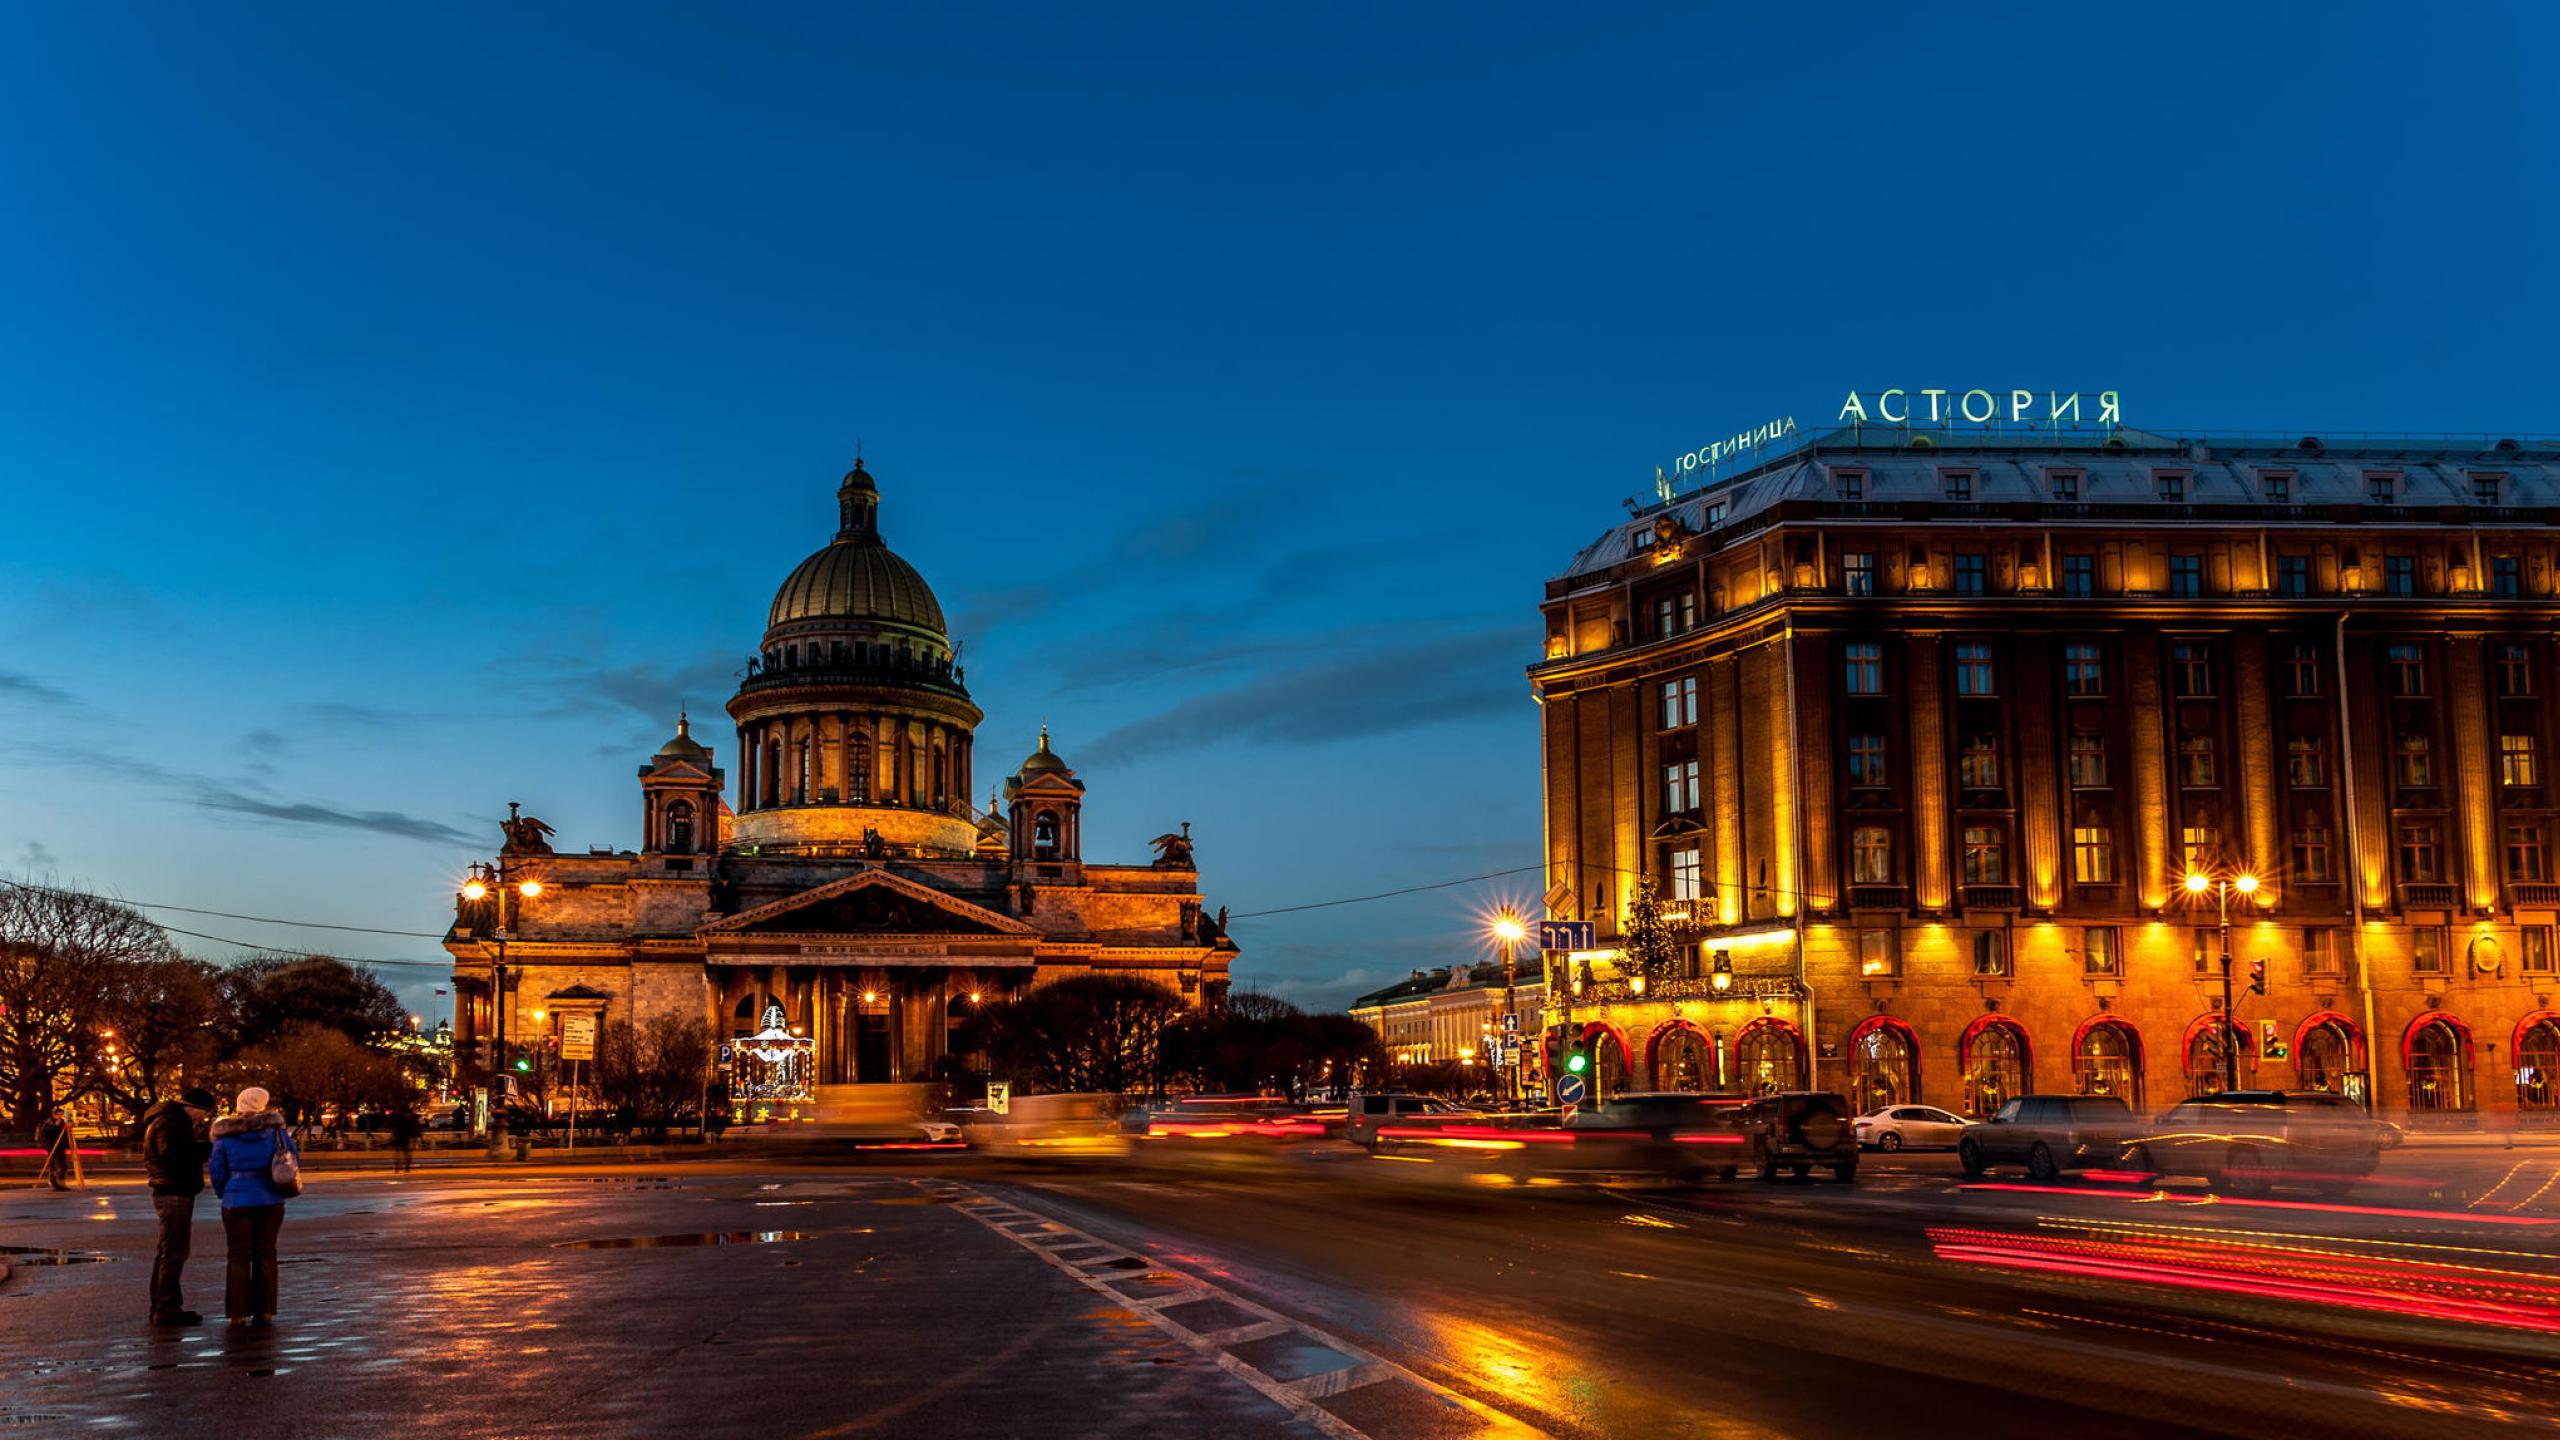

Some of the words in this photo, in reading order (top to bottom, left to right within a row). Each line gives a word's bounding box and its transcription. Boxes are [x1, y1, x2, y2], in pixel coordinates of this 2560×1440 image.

[1838, 389, 2120, 422] АСТОРИЯ
[1675, 415, 1796, 474] ГОСТИНИЦА
[721, 1046, 731, 1061] P
